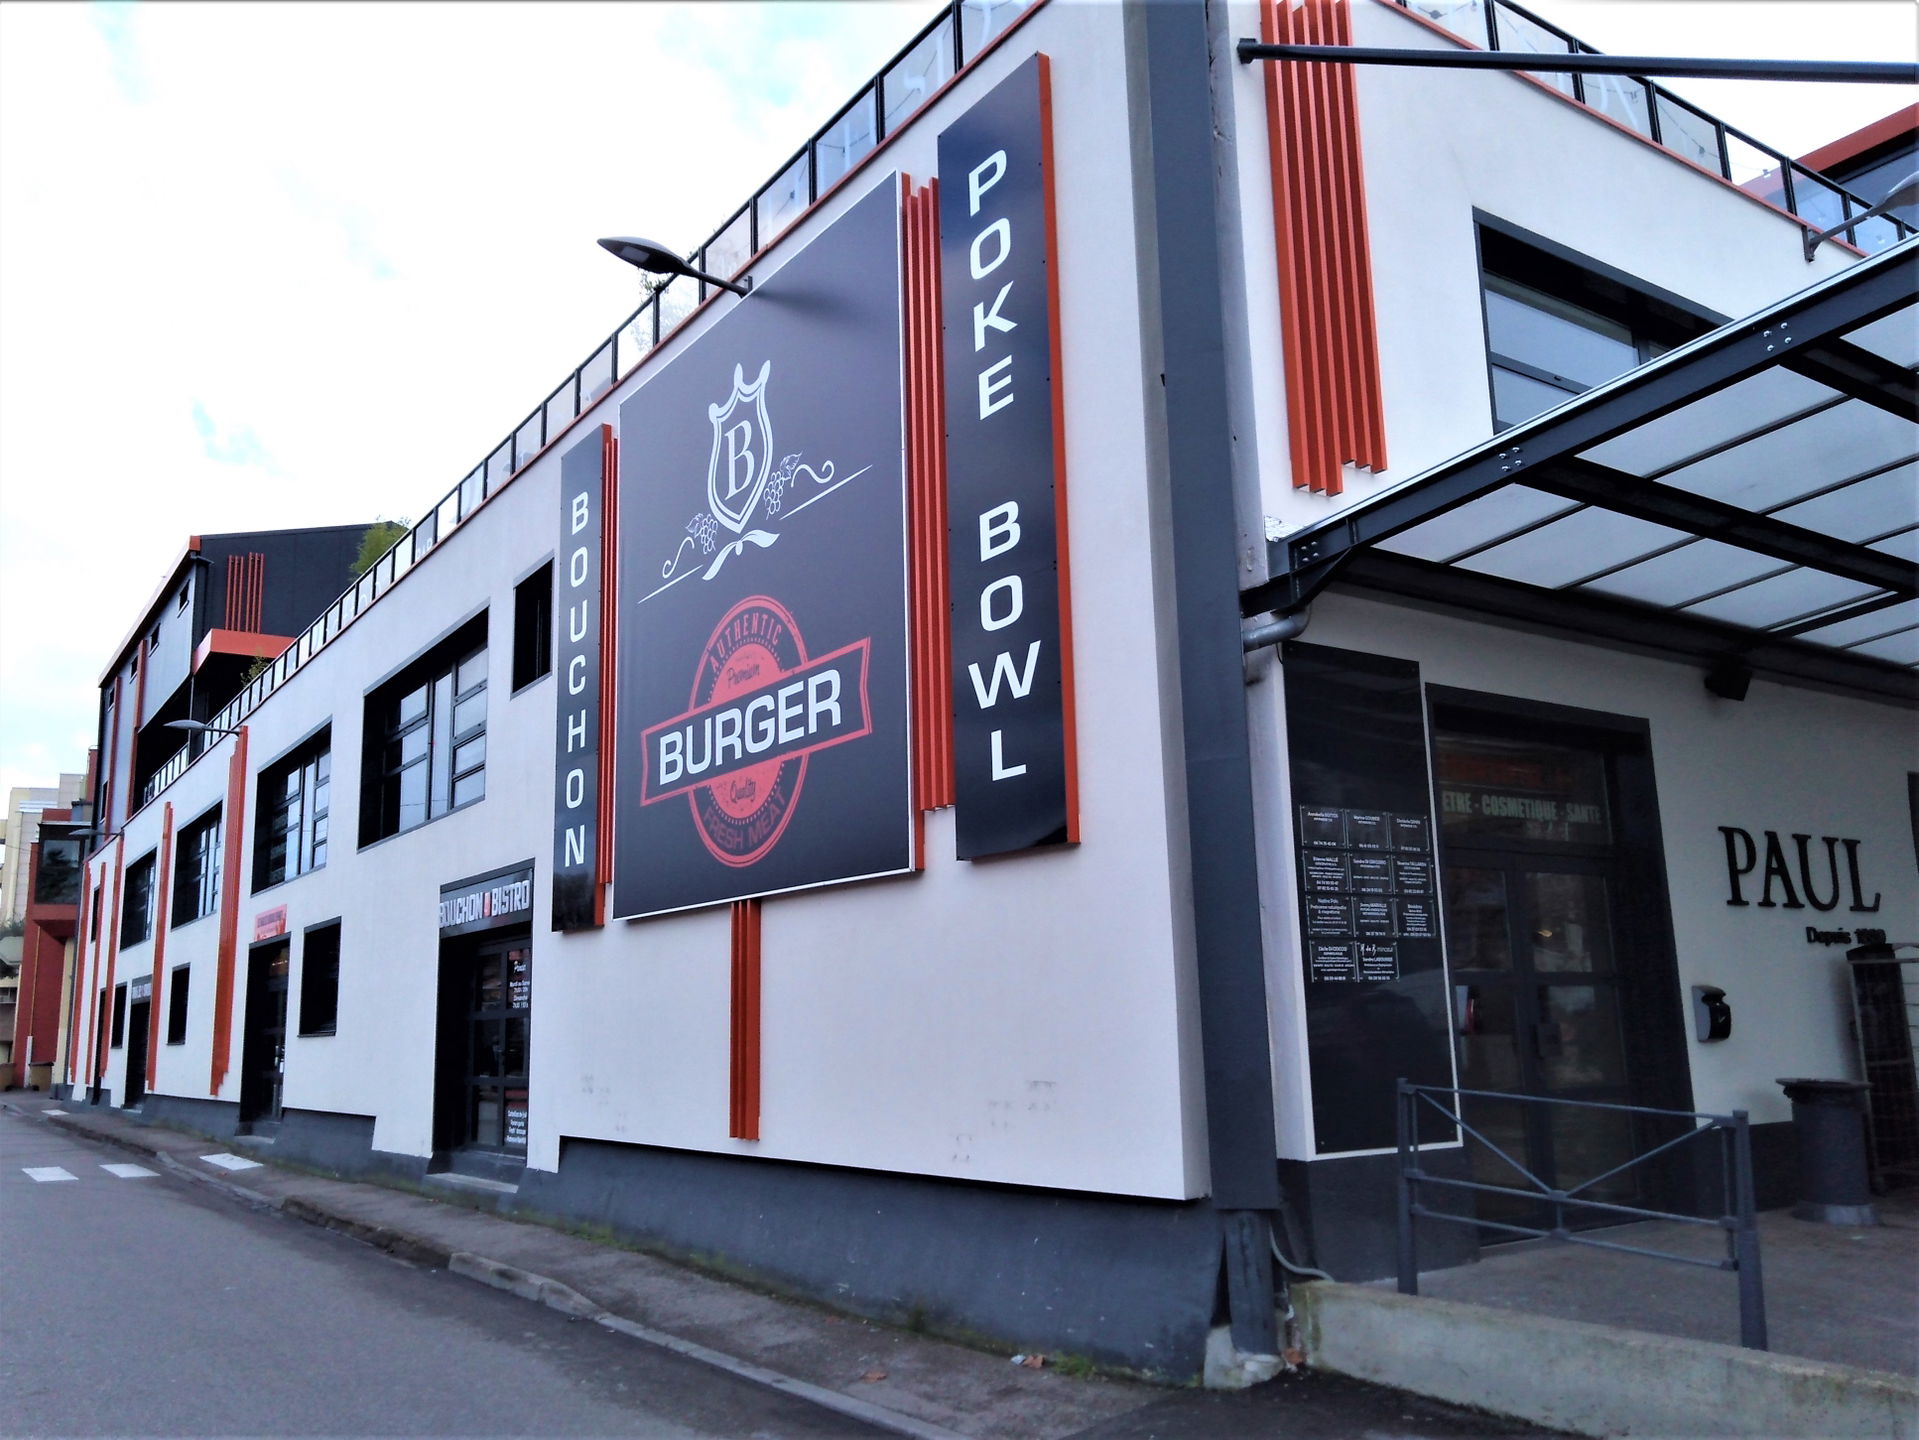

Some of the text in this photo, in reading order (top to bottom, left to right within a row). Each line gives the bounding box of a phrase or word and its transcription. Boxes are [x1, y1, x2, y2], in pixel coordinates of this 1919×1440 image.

[724, 419, 755, 501] B
[968, 149, 1041, 782] POKE BOWL
[564, 490, 590, 868] BOUCHON
[709, 612, 783, 672] AUTHENTIC
[658, 668, 842, 786] BURGER
[703, 786, 786, 850] FRESH MEAT
[1442, 789, 1473, 814] ETRE
[1481, 794, 1558, 822] COSMETIQUE
[439, 879, 530, 929] BOUCHON BISTRO
[1717, 825, 1882, 912] PAUL
